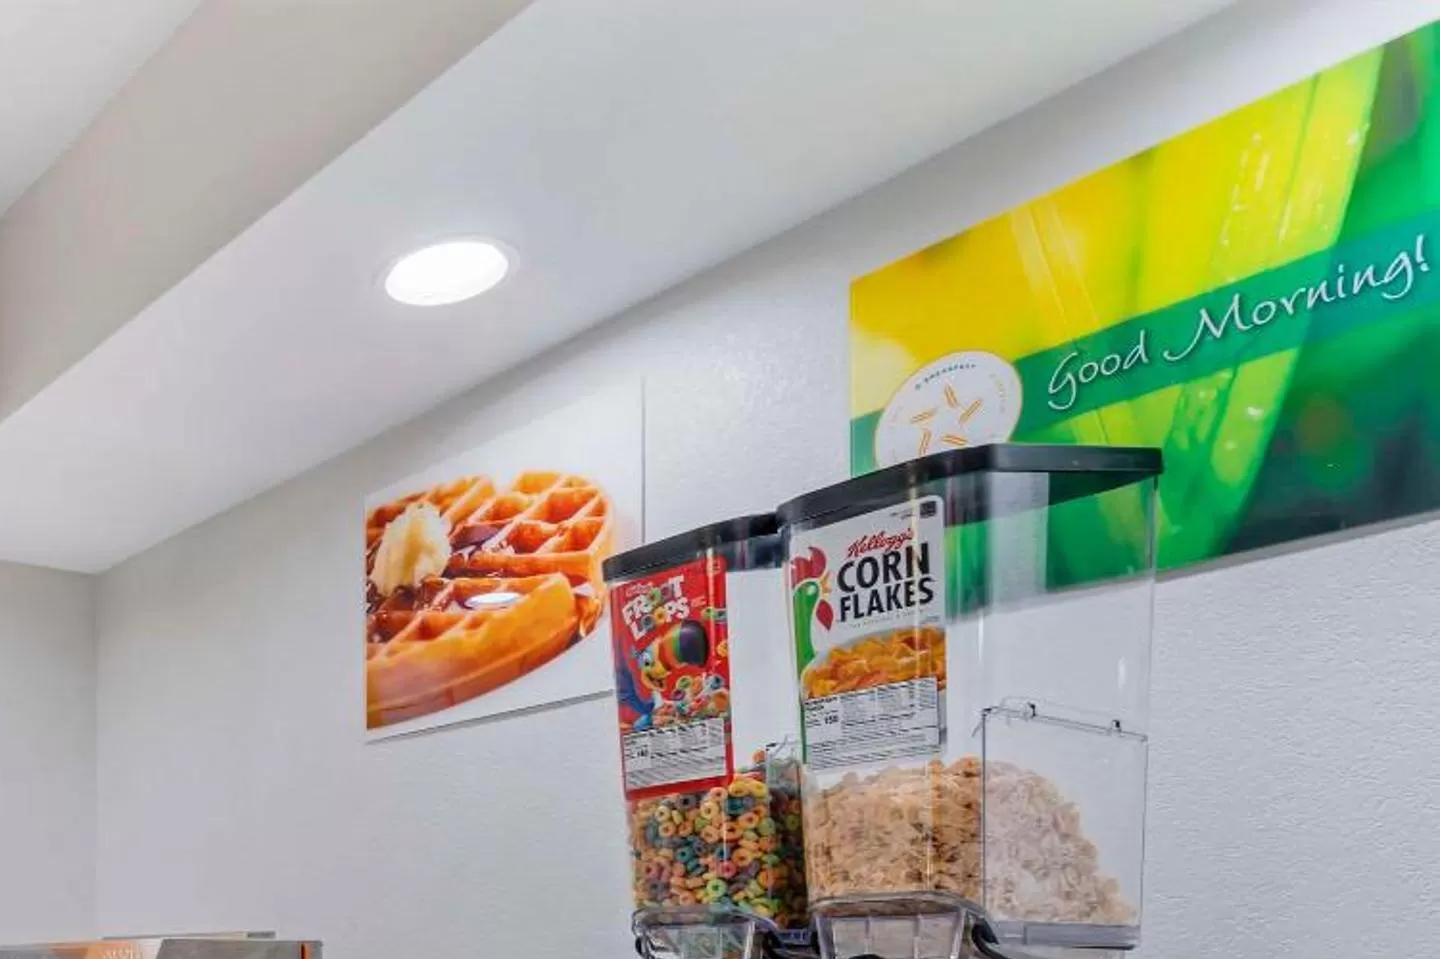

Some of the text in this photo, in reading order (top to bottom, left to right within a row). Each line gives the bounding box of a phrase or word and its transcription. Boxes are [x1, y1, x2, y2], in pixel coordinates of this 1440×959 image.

[1047, 329, 1150, 411] Good
[1162, 233, 1431, 362] Morning!
[837, 542, 931, 594] CORN
[839, 576, 936, 623] FLAKES
